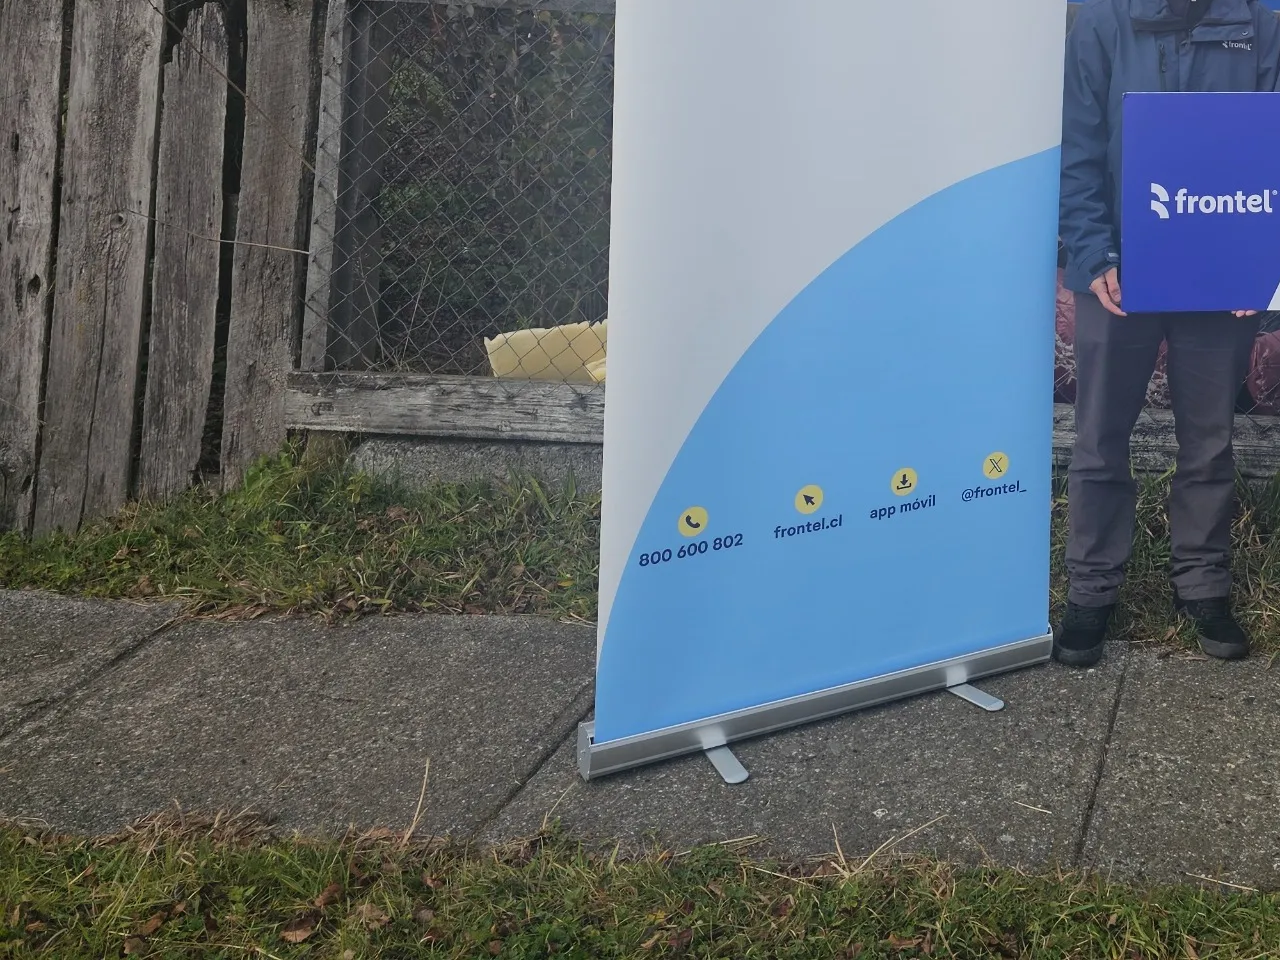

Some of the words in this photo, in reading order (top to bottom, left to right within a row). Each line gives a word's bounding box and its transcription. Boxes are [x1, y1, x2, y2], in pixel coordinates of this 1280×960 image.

[961, 480, 1027, 502] @frontel_
[869, 504, 896, 520] app
[900, 494, 936, 513] móvil
[773, 514, 843, 539] frontel.cl
[638, 548, 672, 567] 800
[677, 540, 708, 559] 600
[712, 533, 744, 551] 802
